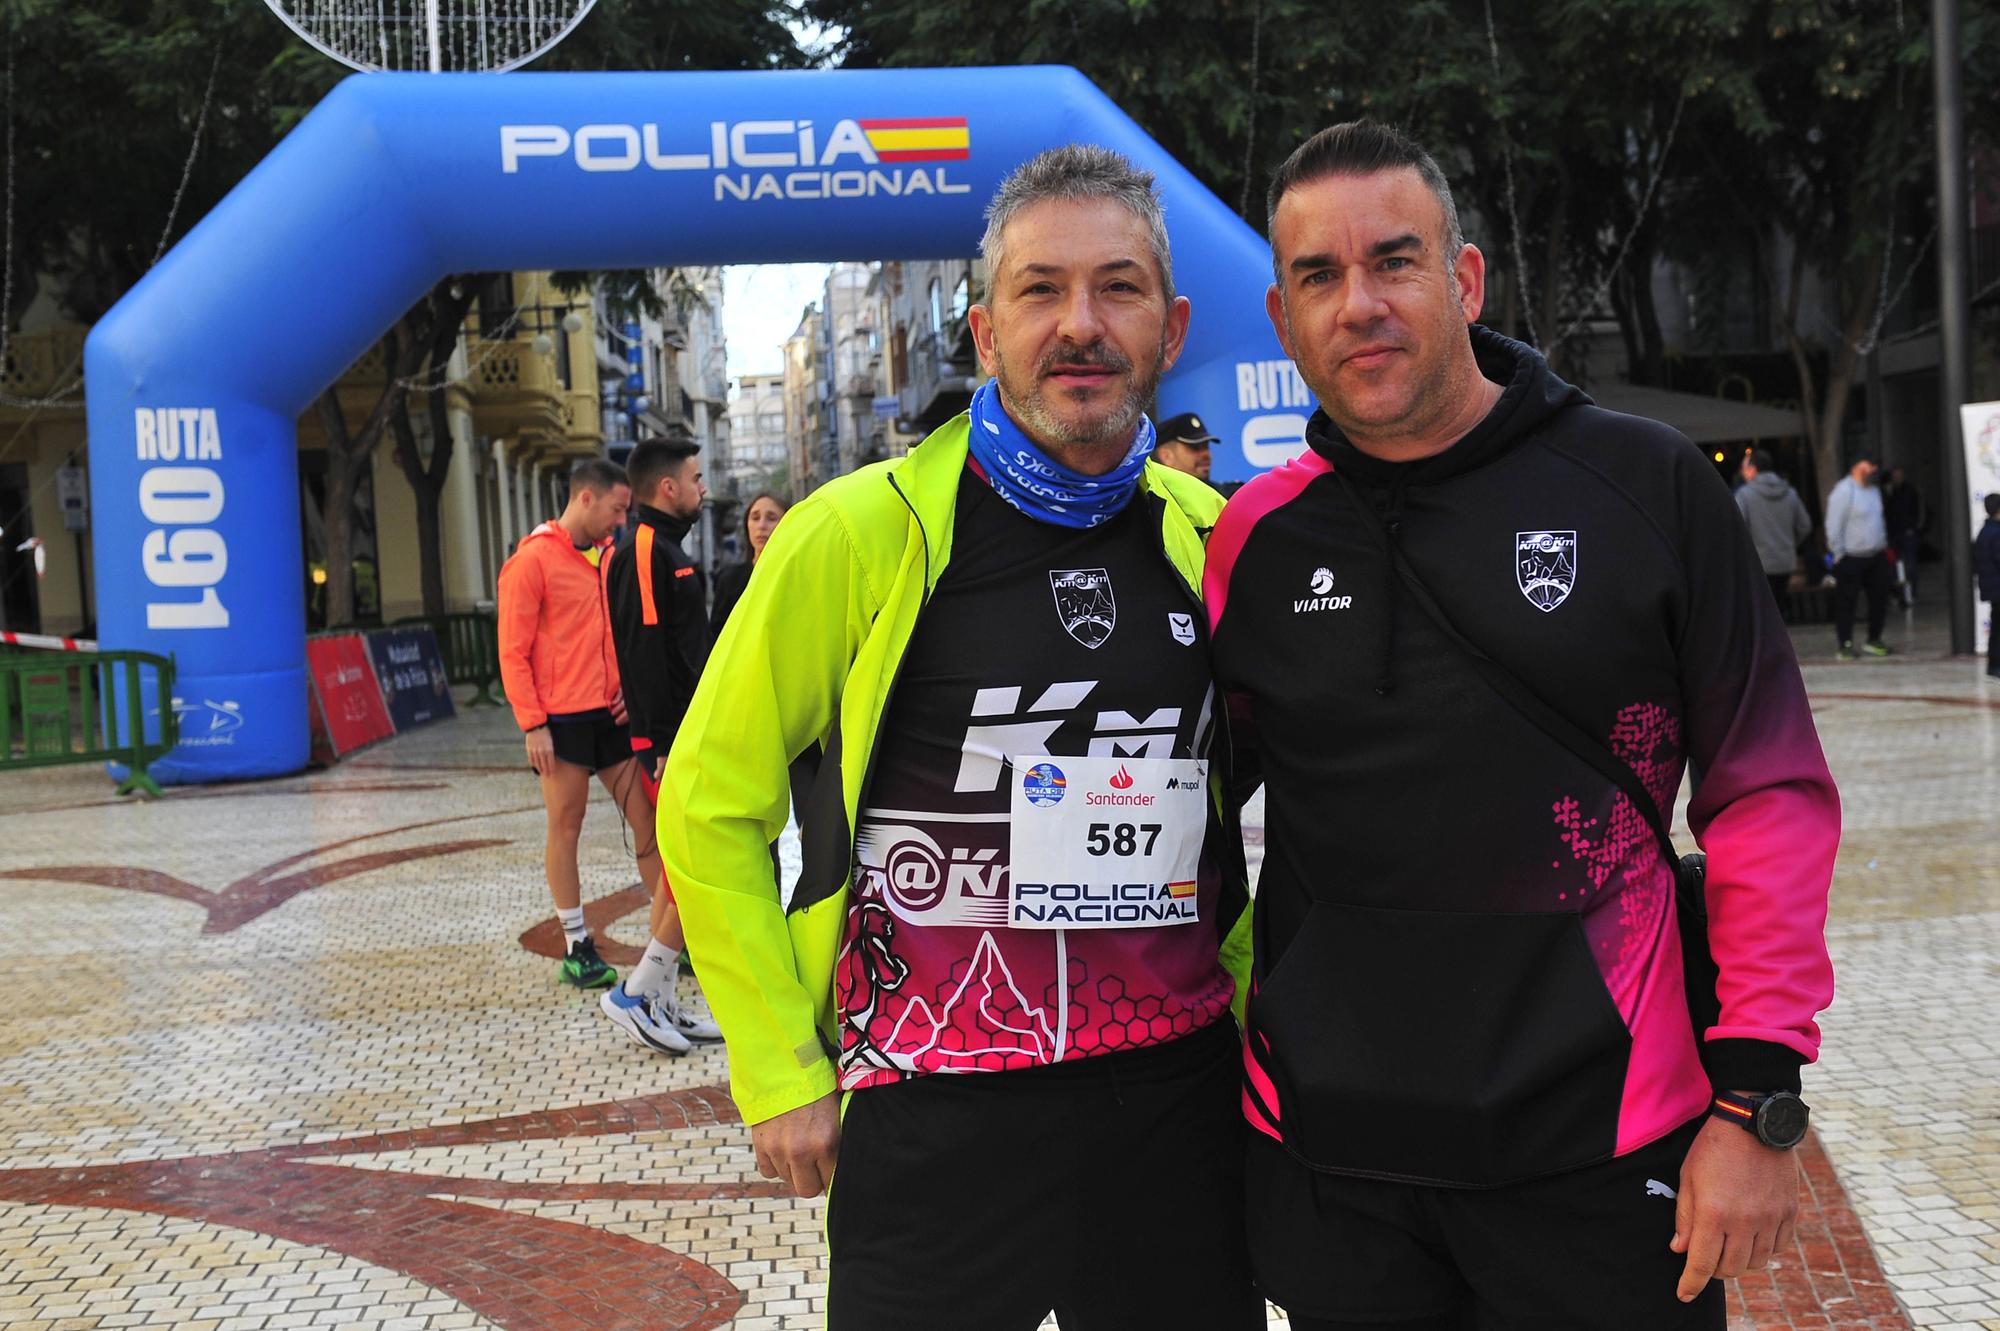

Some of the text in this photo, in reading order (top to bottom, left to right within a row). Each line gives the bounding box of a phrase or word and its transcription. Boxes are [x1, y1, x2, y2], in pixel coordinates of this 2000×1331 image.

[714, 167, 971, 201] NACIONAL
[1235, 359, 1310, 412] RUTA
[134, 407, 223, 461] RUTA
[138, 466, 230, 630] 091
[1293, 596, 1352, 613] VIATOR
[1086, 791, 1155, 806] Santander
[1086, 822, 1162, 857] 587
[1014, 901, 1196, 922] NACIONAL
